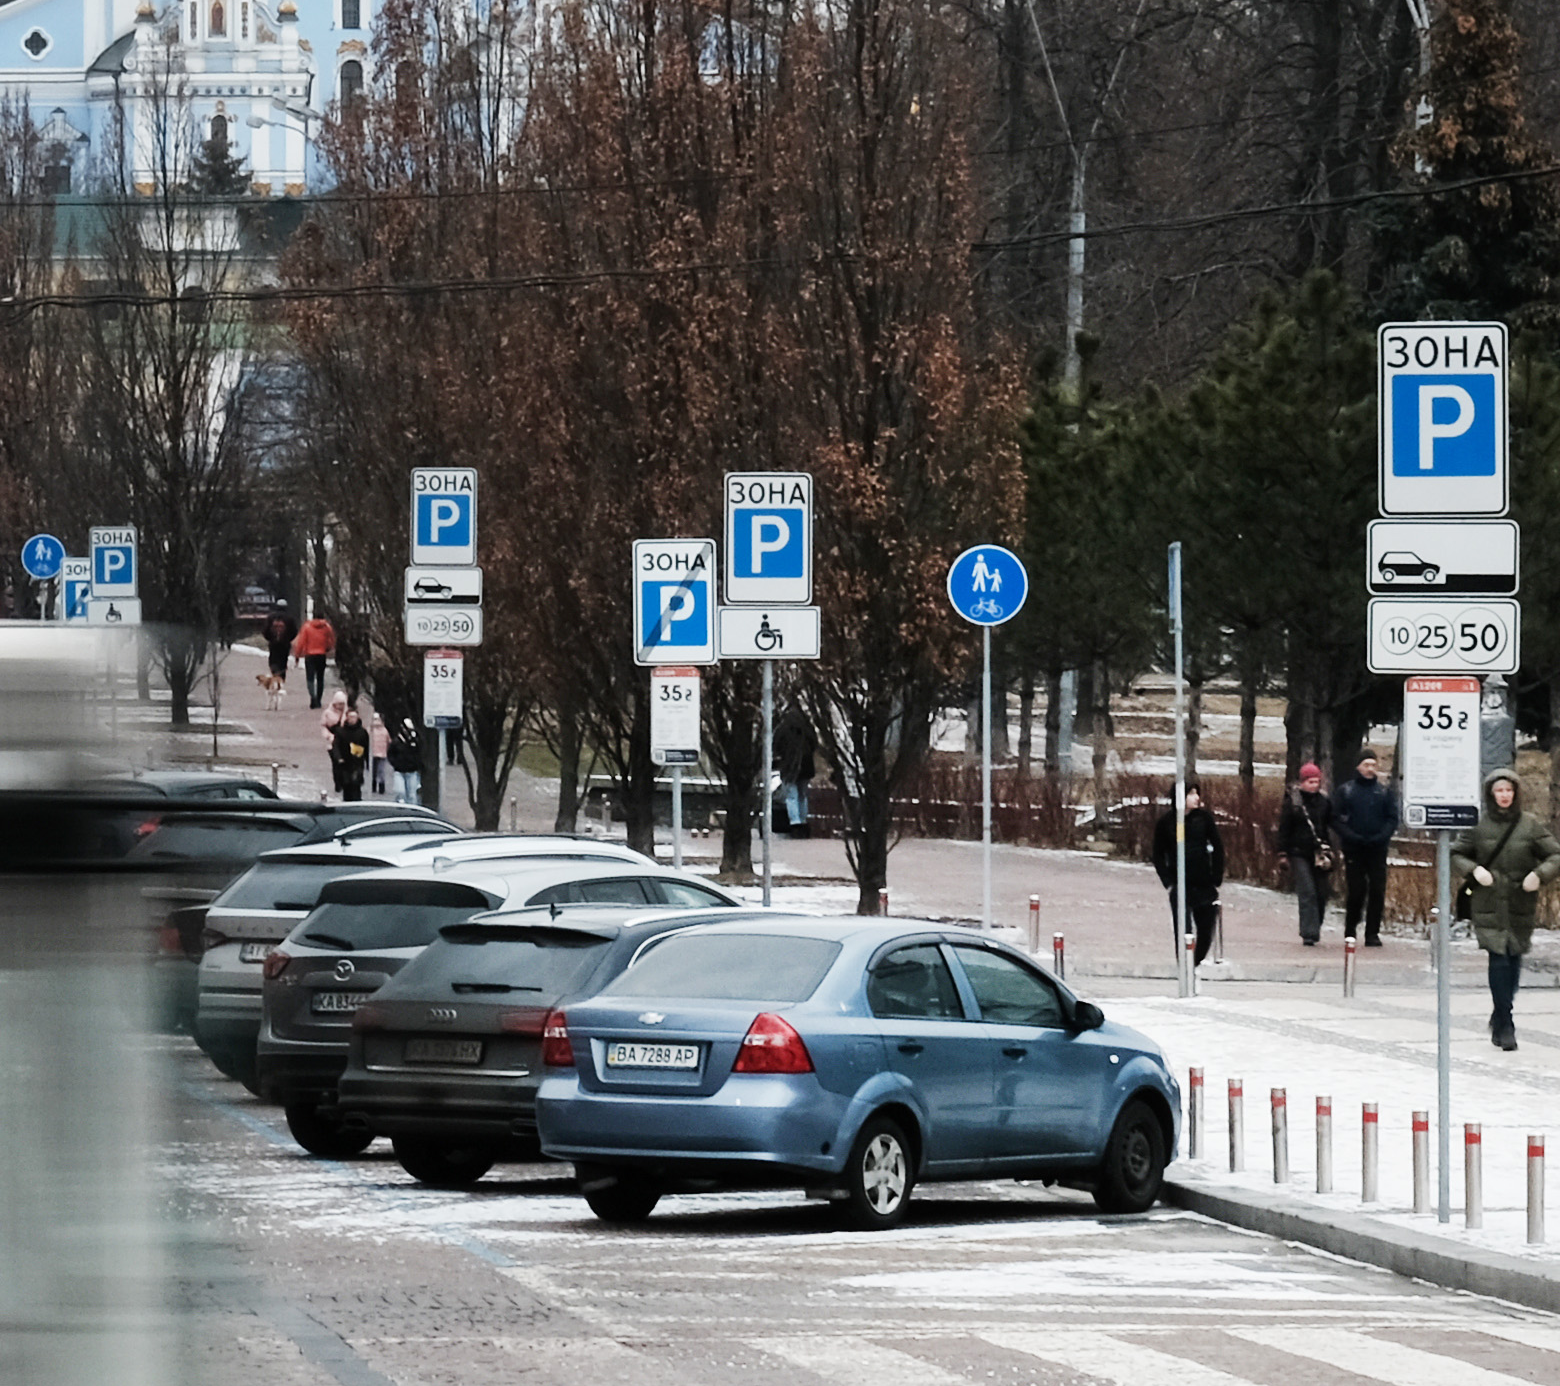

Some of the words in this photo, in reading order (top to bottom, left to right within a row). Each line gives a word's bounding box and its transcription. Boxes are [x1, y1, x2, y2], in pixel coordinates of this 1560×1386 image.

[1387, 335, 1499, 368] ЗОНА
[1418, 384, 1476, 470] P
[415, 475, 472, 492] ЗОНА
[730, 482, 806, 505] ЗОНА
[430, 499, 461, 543] P
[92, 531, 134, 545] ЗОНА
[751, 515, 791, 574] P
[103, 549, 126, 583] P
[642, 552, 706, 571] ЗОНА
[417, 621, 428, 631] 10
[433, 621, 447, 632] 25
[452, 619, 470, 633] 50
[659, 585, 695, 642] P
[1390, 626, 1410, 645] 10
[1417, 625, 1448, 649] 25
[1460, 623, 1499, 652] 50
[617, 1046, 636, 1062] BA
[640, 1047, 671, 1063] 7288
[674, 1048, 694, 1064] AP
